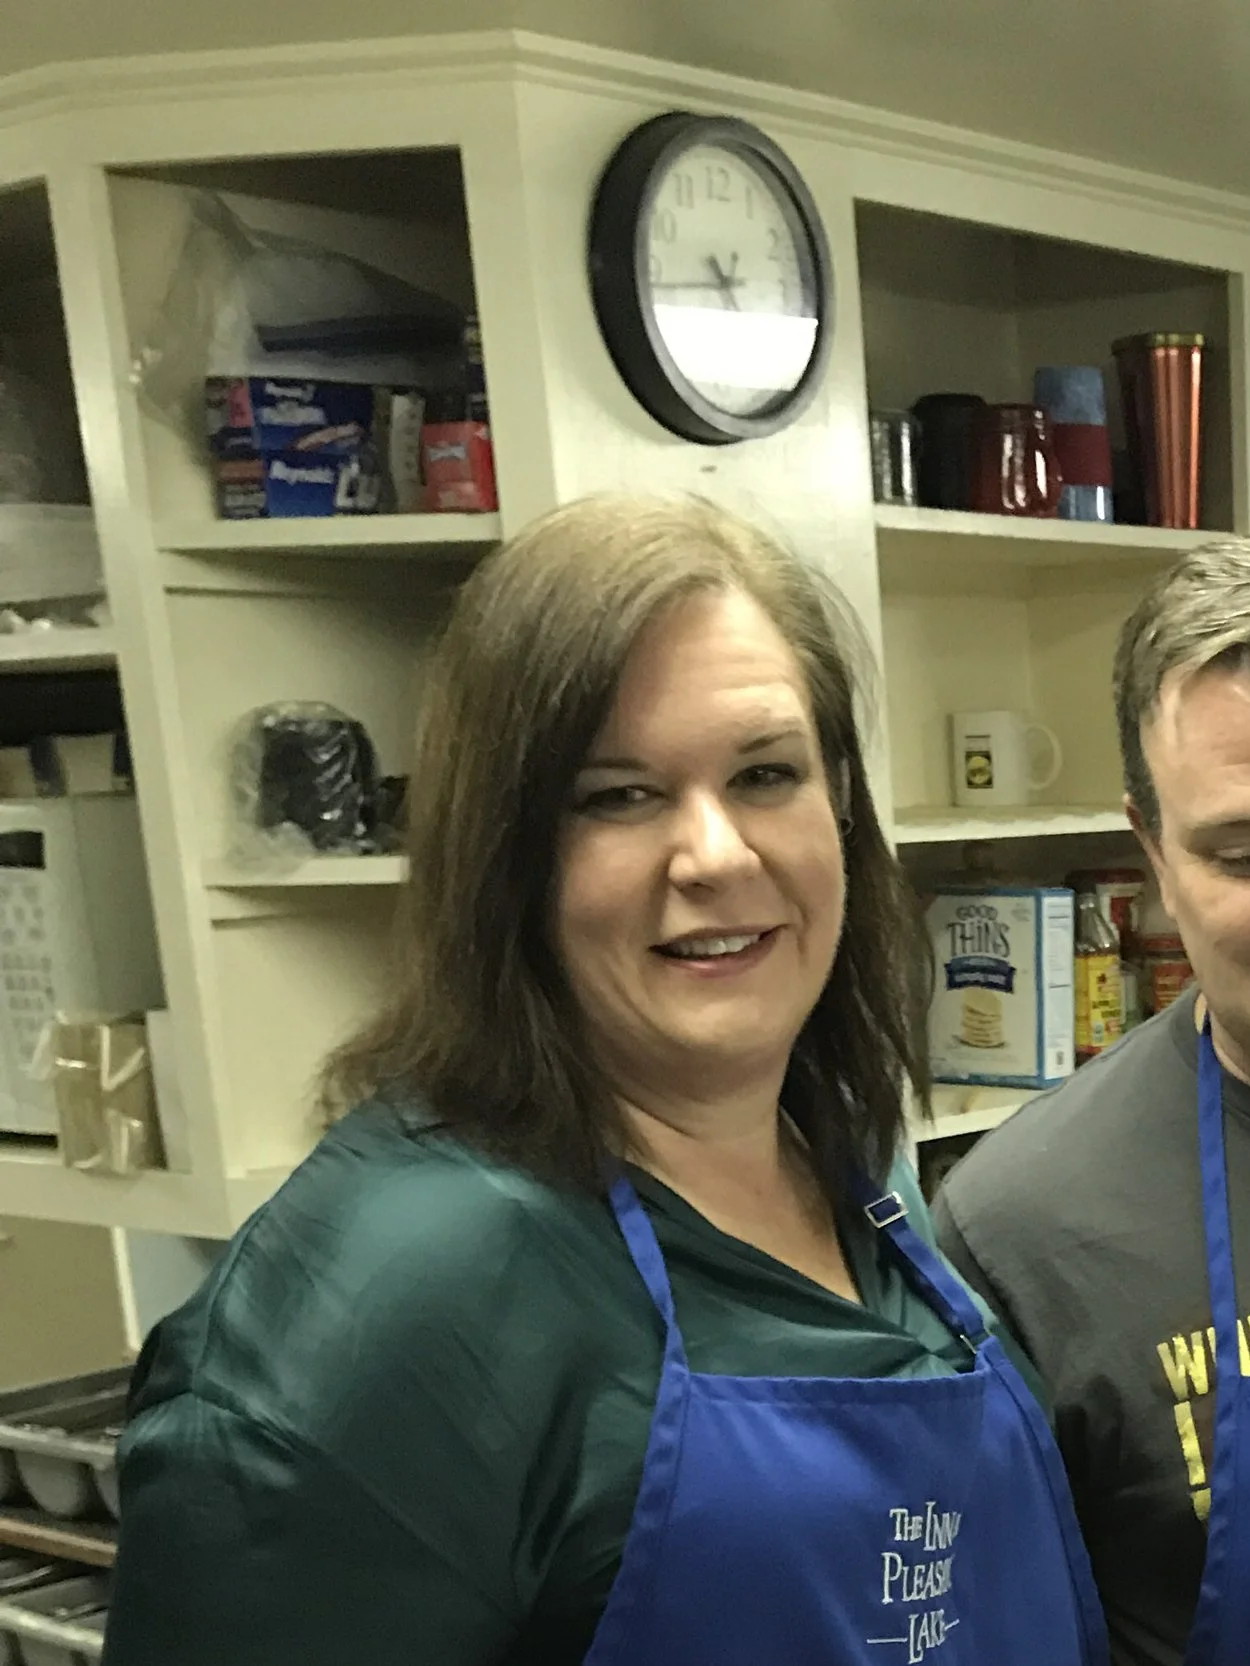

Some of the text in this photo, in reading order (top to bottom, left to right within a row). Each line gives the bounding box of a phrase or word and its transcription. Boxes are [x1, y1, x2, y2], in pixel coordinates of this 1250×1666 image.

[673, 172, 694, 209] 11
[705, 165, 731, 202] 12
[955, 904, 997, 920] GOOD
[889, 1508, 923, 1542] THE
